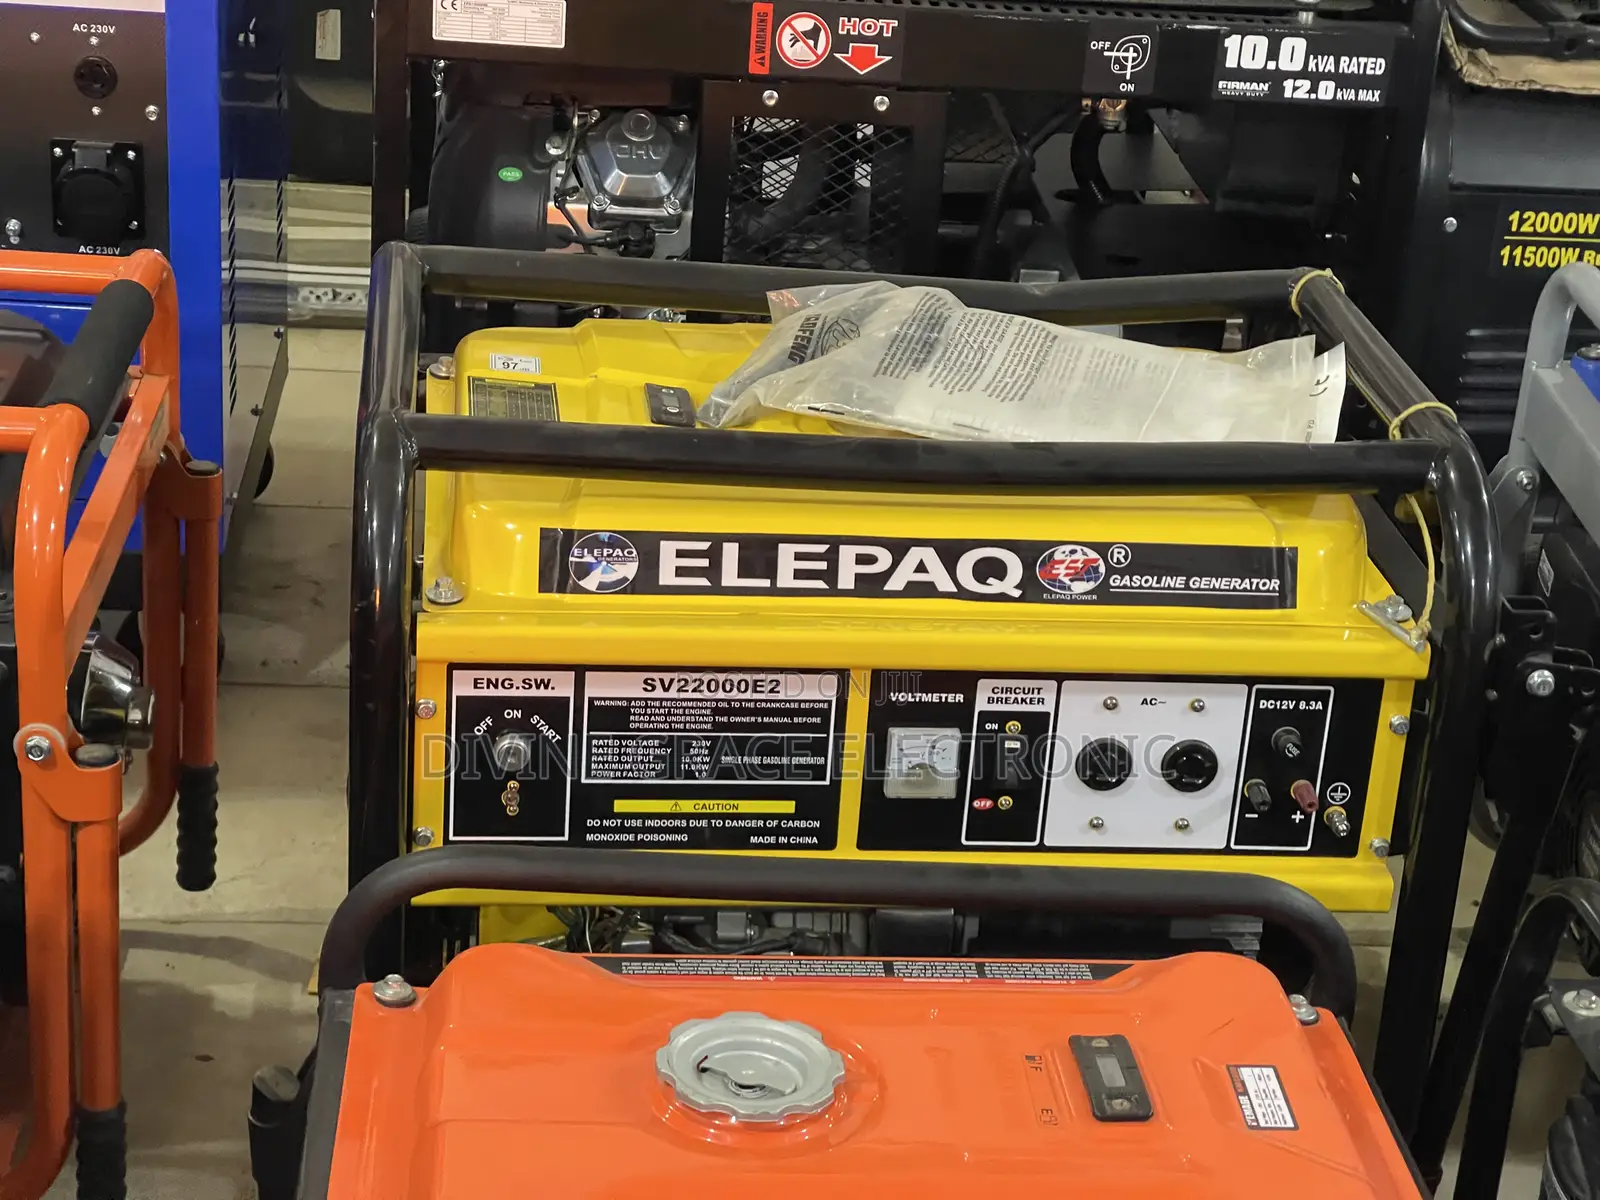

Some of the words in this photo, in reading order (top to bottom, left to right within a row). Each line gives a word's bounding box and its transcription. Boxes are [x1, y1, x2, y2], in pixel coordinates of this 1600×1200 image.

[72, 23, 87, 32] AC
[90, 24, 116, 33] 230V
[838, 17, 898, 37] HOT
[755, 11, 769, 54] WARNING
[1090, 41, 1111, 50] OFF
[1224, 34, 1307, 72] 10.0
[1308, 54, 1336, 73] kVA
[1338, 56, 1386, 75] RATED
[1119, 82, 1135, 92] ON
[1218, 81, 1269, 91] FIRMAN
[1283, 78, 1336, 100] 12.0
[1336, 87, 1356, 102] kVA
[1358, 89, 1381, 103] MAX
[1508, 210, 1600, 234] 12000W
[78, 245, 94, 253] AC
[95, 246, 121, 255] 230V
[1500, 245, 1581, 268] 11500W
[502, 362, 519, 370] 97
[573, 548, 637, 558] ELEPAQ
[658, 540, 1024, 597] ELEPAQ
[1109, 575, 1187, 590] GASOLINE
[1189, 576, 1280, 591] GENERATOR
[473, 677, 556, 690] ENG.SW.
[642, 677, 781, 694] SV22000E2
[991, 686, 1043, 695] CIRCUIT
[890, 692, 964, 703] VOLTMETER
[987, 696, 1046, 705] BREAKER
[1259, 700, 1296, 710] DC12V
[1299, 700, 1323, 710] 8.3A
[504, 709, 522, 719] ON
[474, 715, 495, 736] OFF
[530, 714, 562, 744] START
[985, 723, 999, 731] ON
[721, 755, 742, 764] SINGLE
[743, 756, 762, 764] PHASE
[762, 756, 791, 764] GASOLINE
[791, 757, 825, 765] GENERATOR
[693, 802, 740, 811] CAUTION
[973, 800, 993, 808] OFF
[586, 819, 601, 827] DO
[602, 819, 622, 827] NOT
[624, 819, 643, 827] USE
[645, 819, 687, 828] INDOORS
[689, 819, 709, 828] DUE
[710, 819, 723, 828] TO
[725, 819, 764, 828] DANGER
[766, 820, 779, 828] OF
[781, 820, 820, 829] CARBON
[586, 833, 635, 842] MONOXIDE
[637, 833, 689, 842] POISONING
[750, 835, 777, 844] MADE
[778, 836, 788, 844] IN
[789, 836, 819, 844] CHINA
[1041, 1108, 1053, 1116] E
